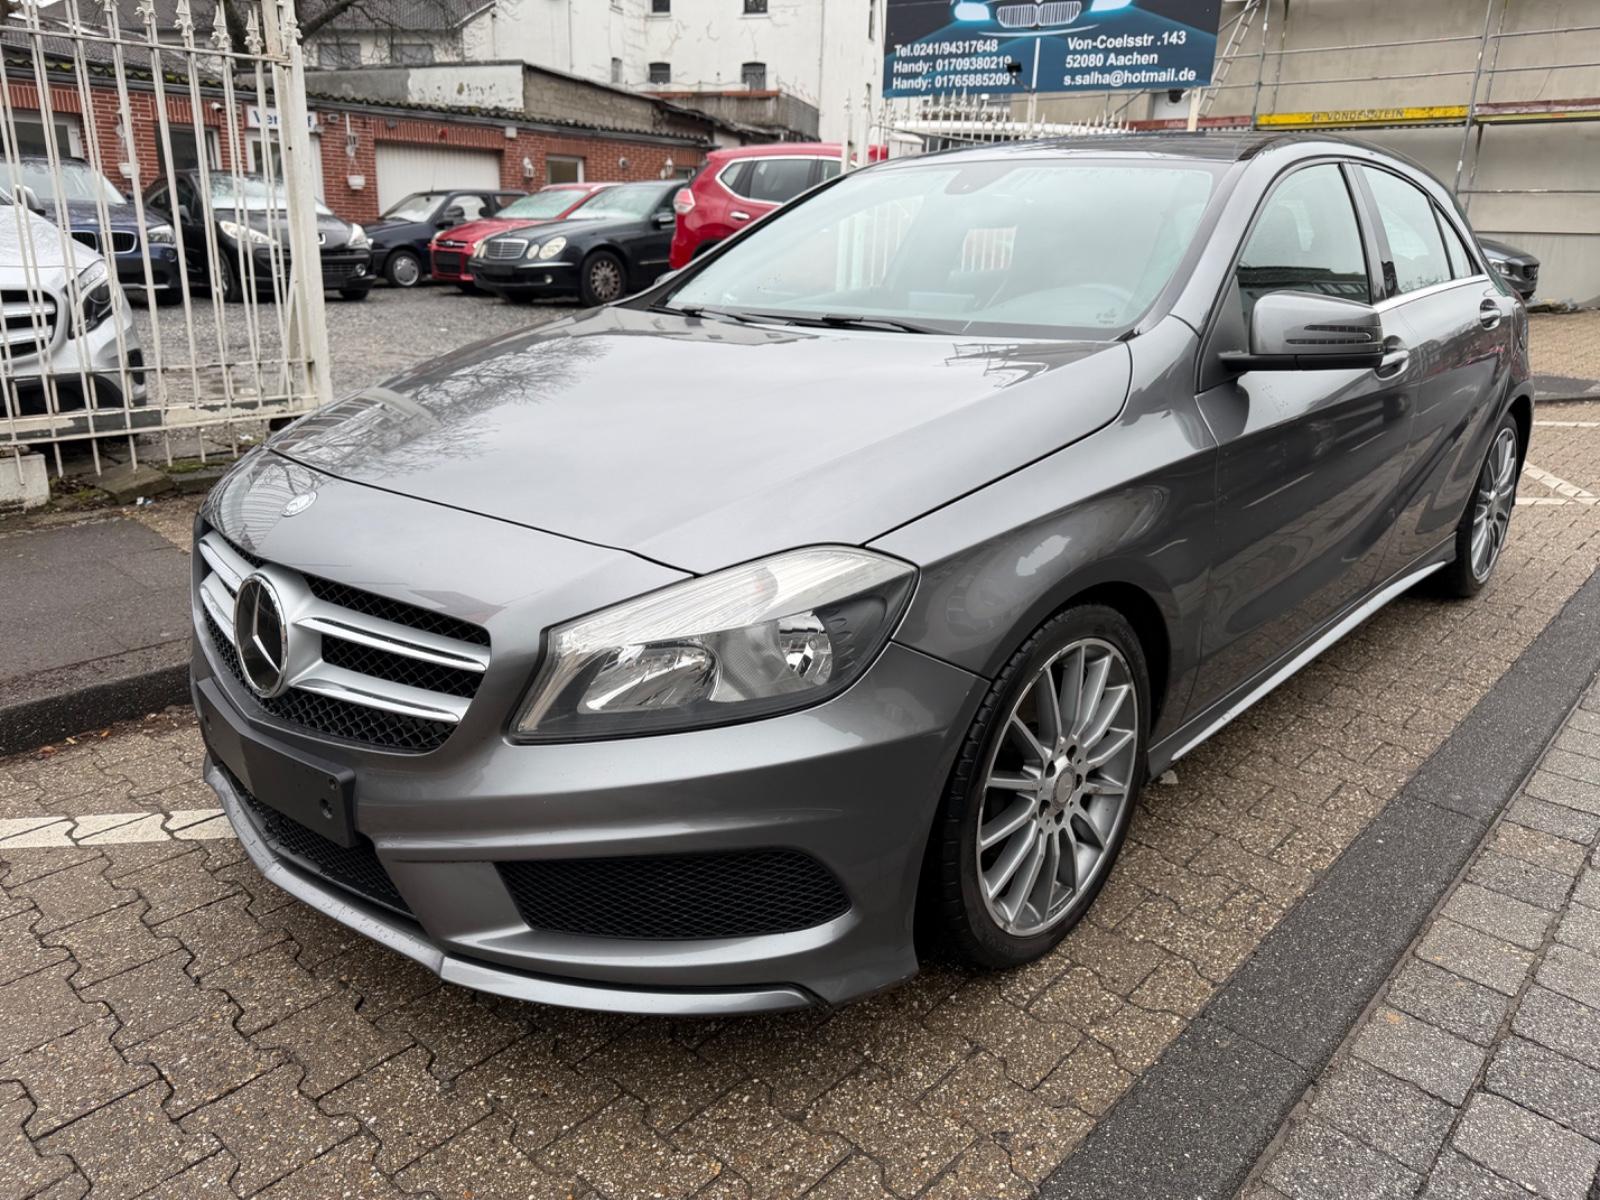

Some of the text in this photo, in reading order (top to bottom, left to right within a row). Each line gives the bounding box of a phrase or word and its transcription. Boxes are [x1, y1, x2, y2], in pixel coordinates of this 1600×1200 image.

[894, 39, 998, 57] Tel.0241/94317648
[1067, 33, 1154, 50] Von-Coelsstr
[893, 59, 933, 75] Handy:
[1065, 51, 1158, 68] 52080 Aachen
[892, 76, 932, 91] Handy:
[1063, 67, 1196, 87] s.salha@hotmail.de
